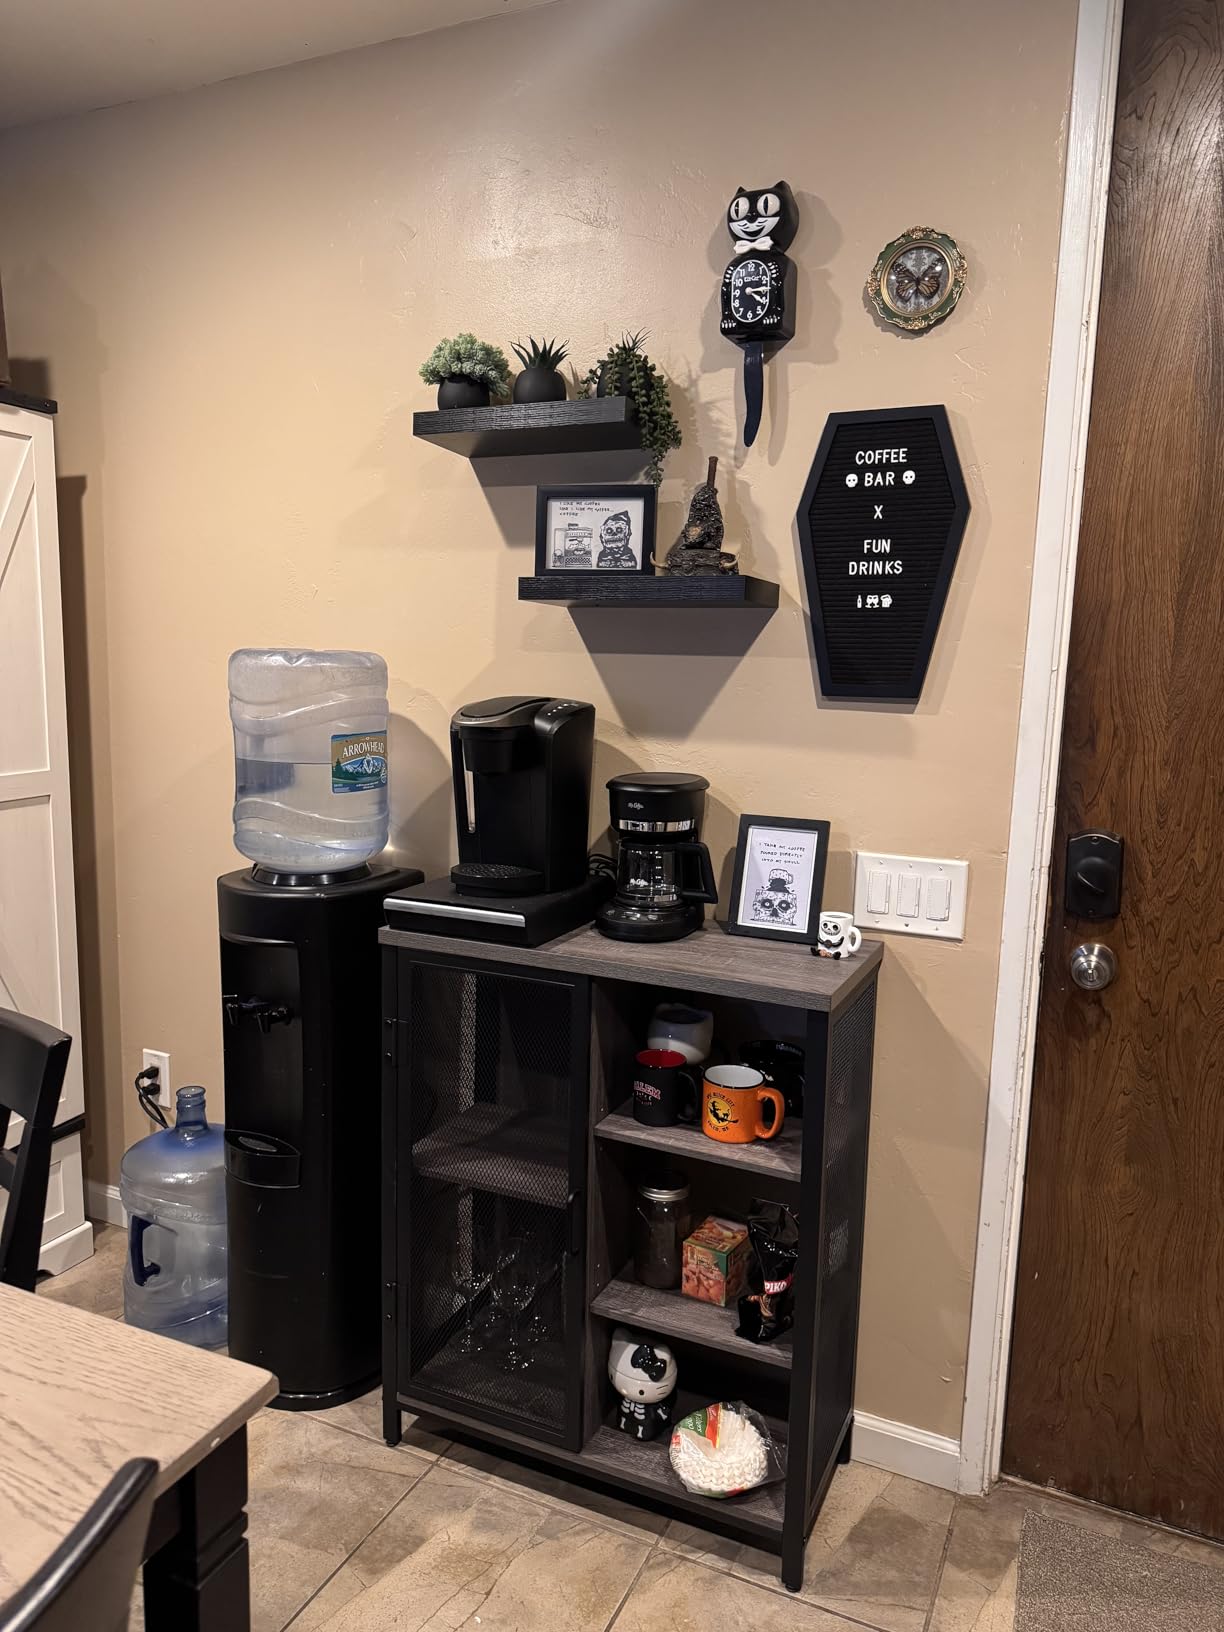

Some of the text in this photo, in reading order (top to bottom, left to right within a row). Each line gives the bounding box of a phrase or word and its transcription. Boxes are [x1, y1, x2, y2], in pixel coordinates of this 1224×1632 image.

[748, 263, 755, 272] 12
[740, 269, 745, 277] 11
[735, 279, 743, 287] 10
[762, 276, 766, 284] 2
[735, 289, 740, 297] 9
[734, 299, 739, 307] 8
[756, 306, 762, 314] 5
[747, 311, 752, 319] 6
[855, 448, 908, 465] COFFEE
[864, 472, 895, 487] BAR
[873, 505, 883, 519] X
[864, 539, 891, 554] FUN
[849, 560, 903, 576] DRINKS
[342, 741, 384, 758] ARROWHEAD
